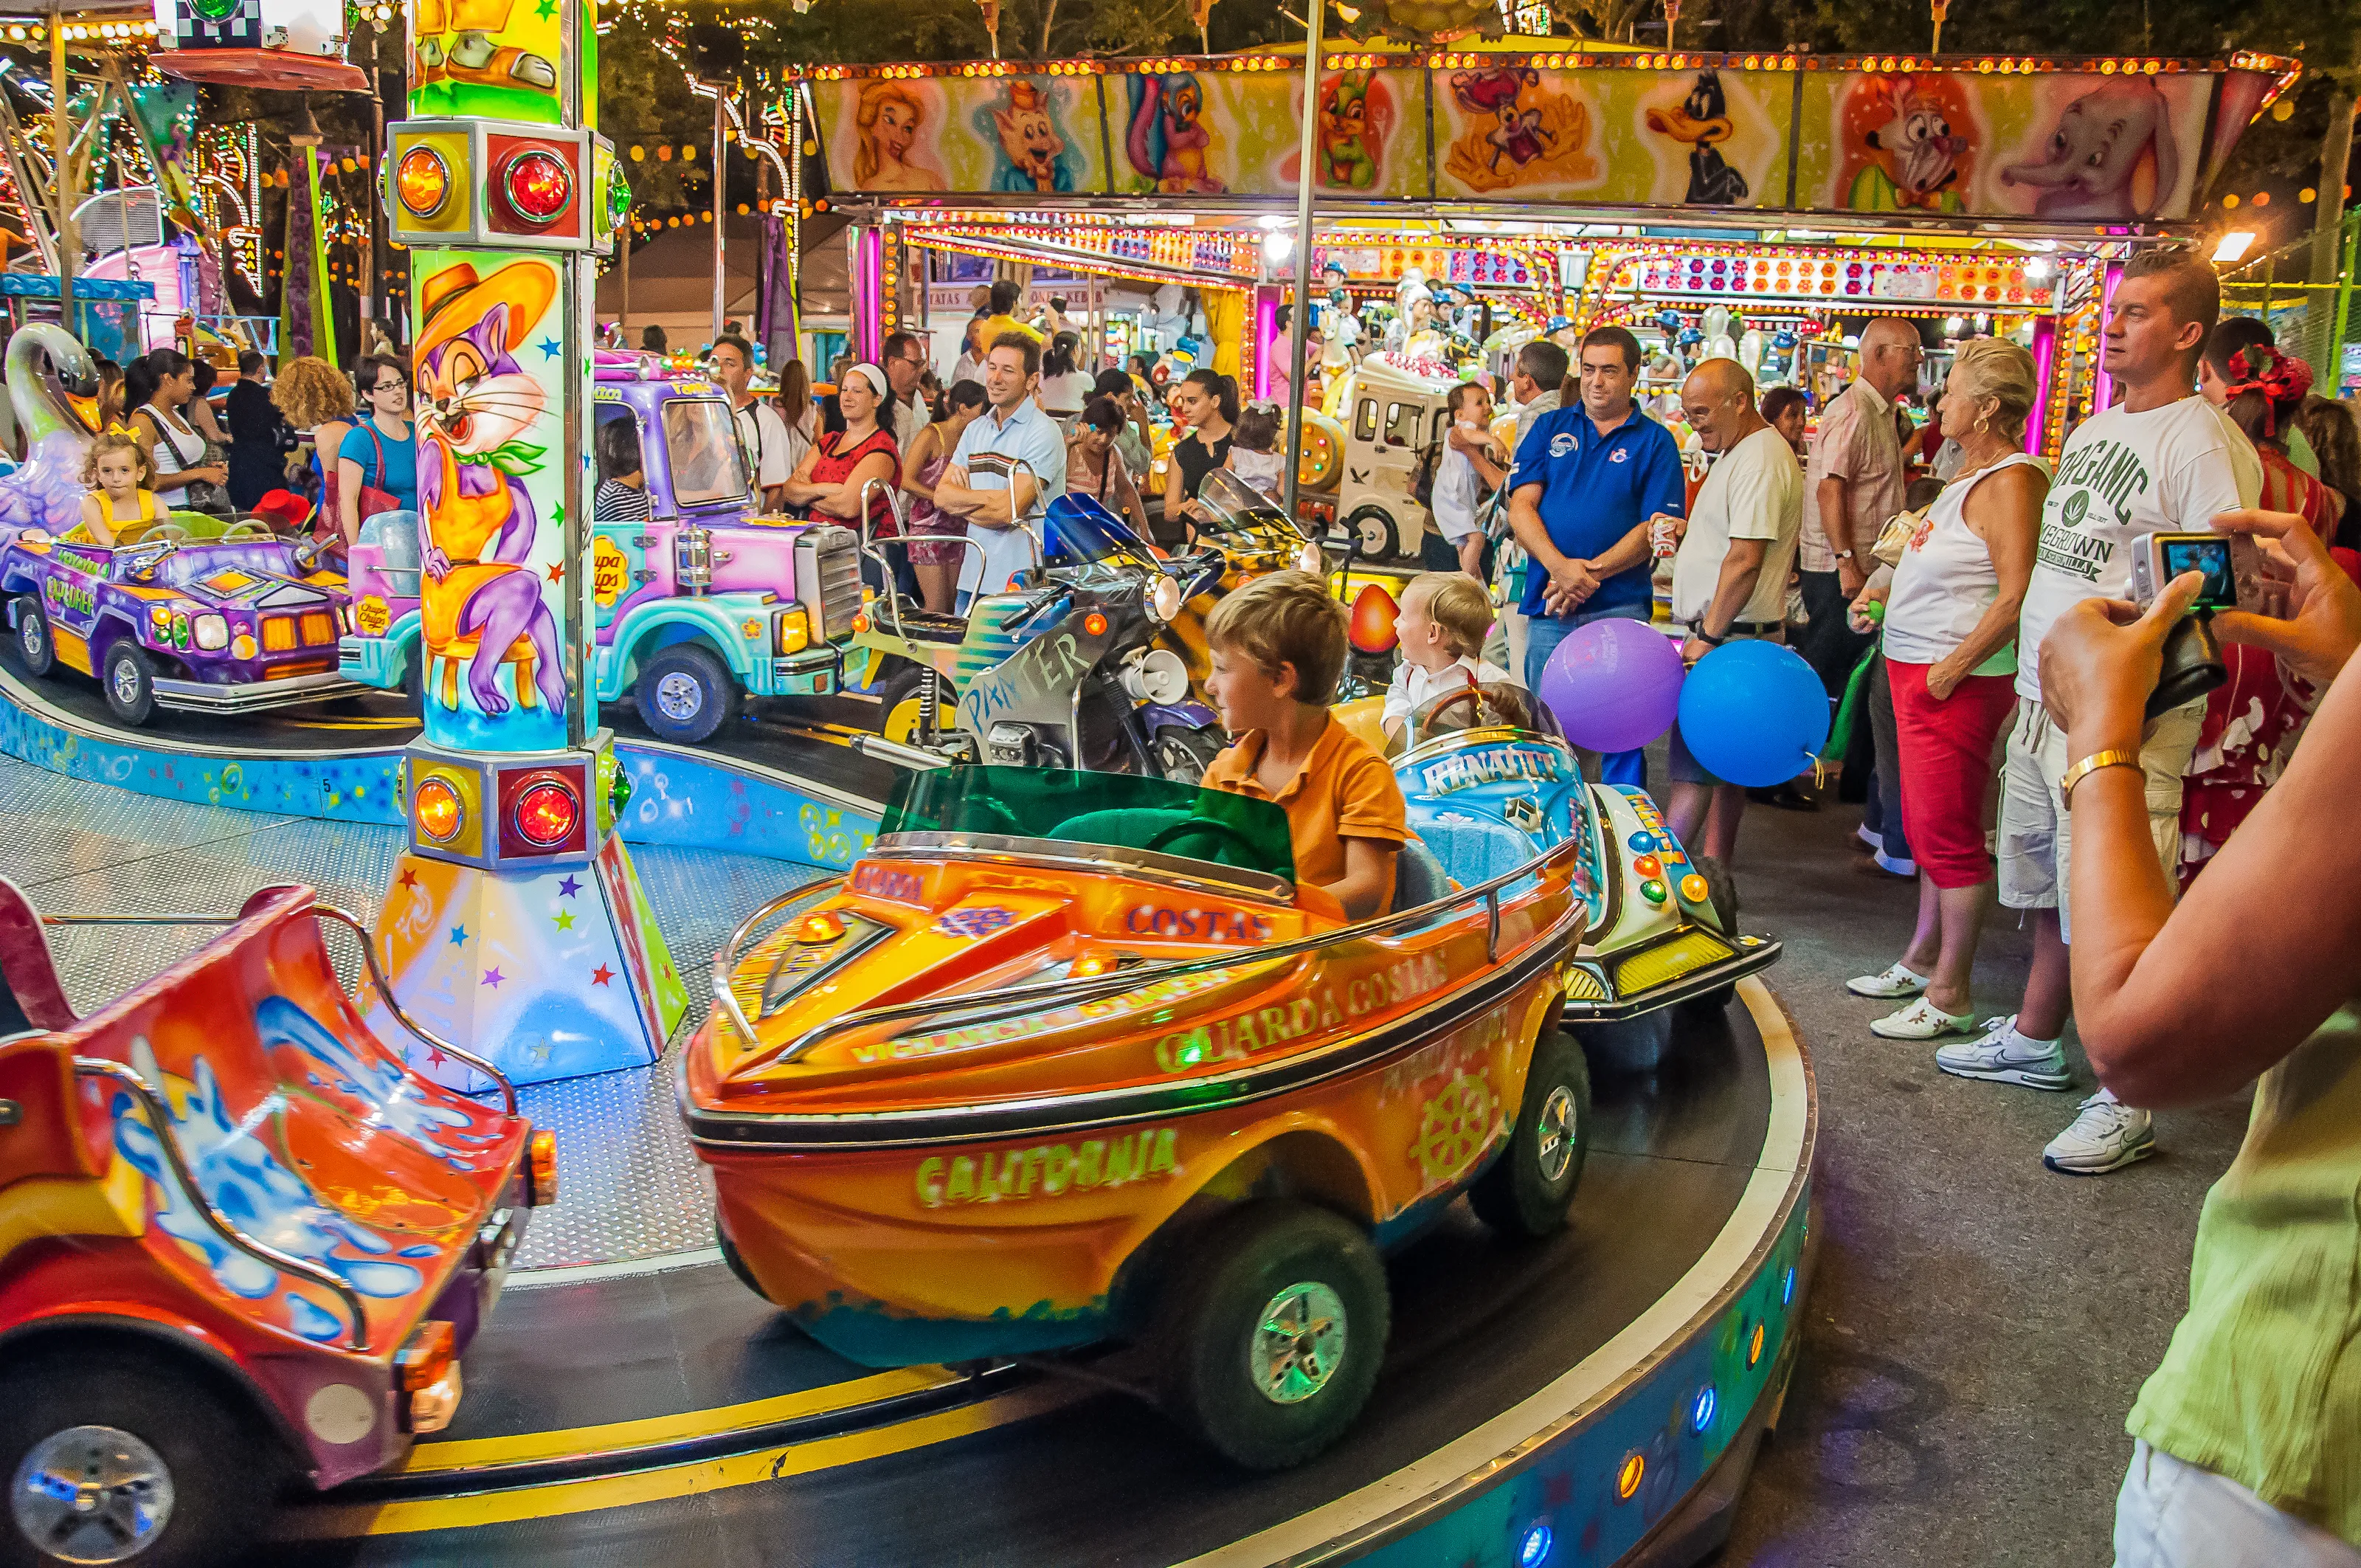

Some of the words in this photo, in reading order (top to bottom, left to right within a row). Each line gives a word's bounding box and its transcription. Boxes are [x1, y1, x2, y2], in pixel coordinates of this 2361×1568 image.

[916, 292, 960, 304] PTATAS
[1065, 290, 1102, 302] KEBB
[2052, 440, 2148, 525] ORGANIC
[963, 633, 1091, 736] PANTER
[322, 778, 331, 792] 5
[1422, 750, 1559, 798] RENAULT
[1127, 904, 1273, 941] COSTAS
[1071, 968, 1240, 1018] DUANERA
[1155, 990, 1344, 1074] GUARDA
[1348, 948, 1448, 1015] COSTAS
[916, 1127, 1180, 1209] CALIFORNIA
